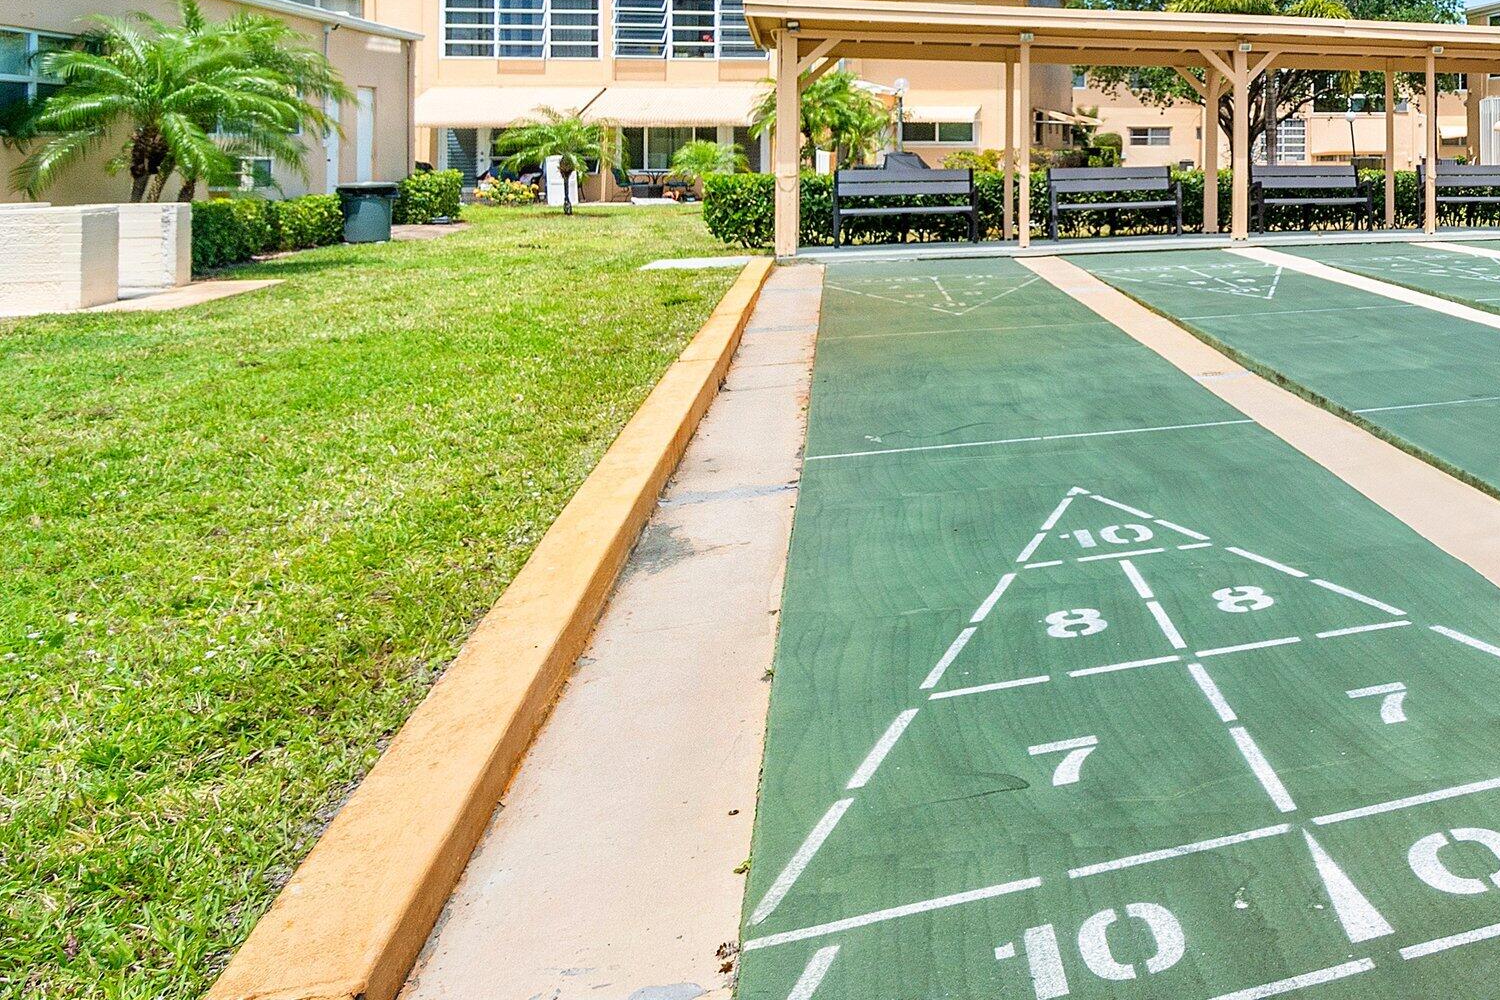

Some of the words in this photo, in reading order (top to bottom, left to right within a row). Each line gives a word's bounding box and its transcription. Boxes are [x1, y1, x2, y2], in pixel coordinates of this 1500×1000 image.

[1060, 523, 1154, 548] 10
[1211, 585, 1274, 613] 8
[1045, 607, 1108, 638] 8
[1346, 682, 1408, 724] 7
[1028, 735, 1098, 786] 7
[993, 901, 1186, 1000] 10
